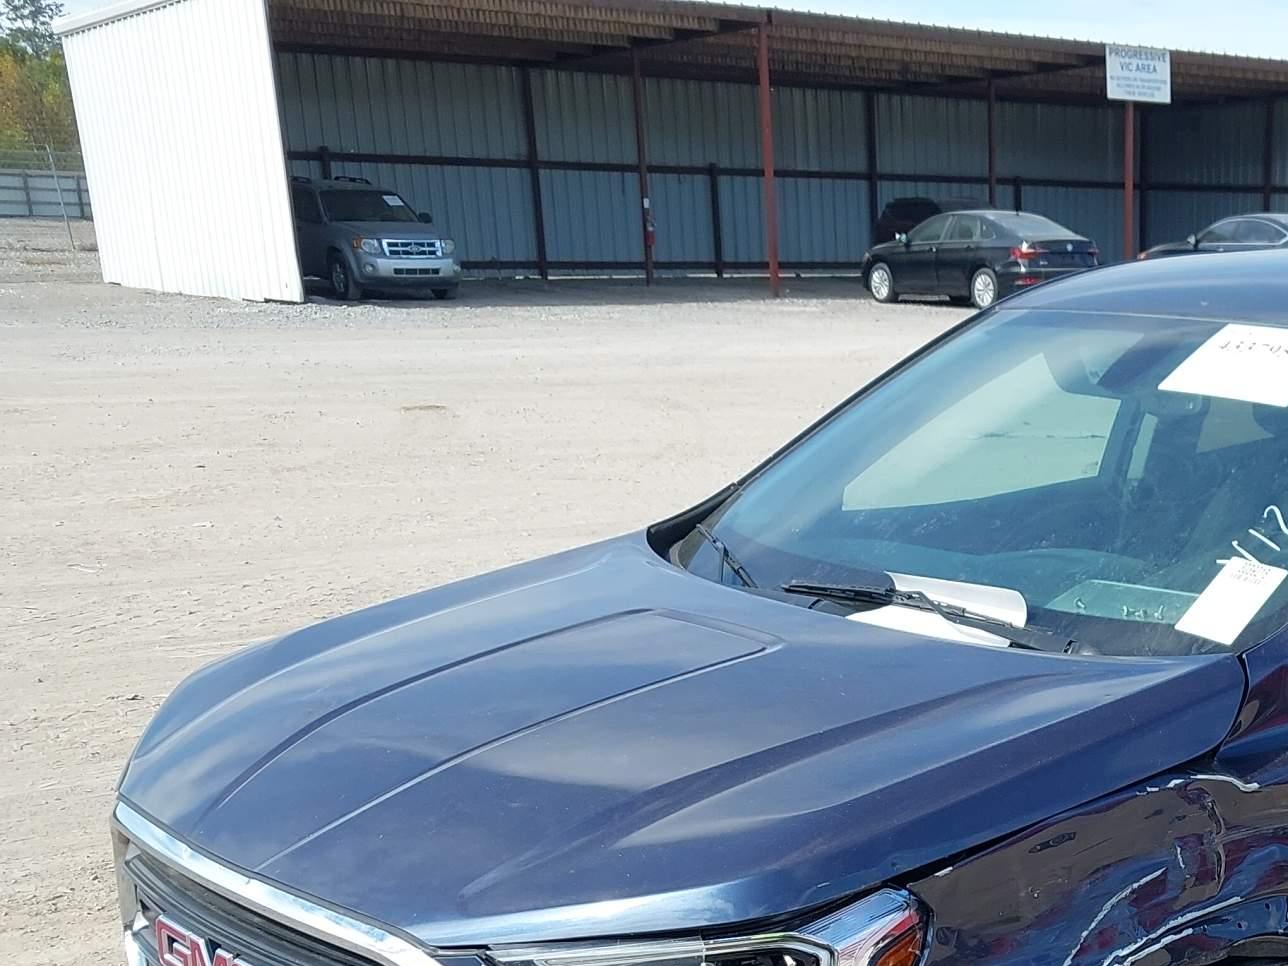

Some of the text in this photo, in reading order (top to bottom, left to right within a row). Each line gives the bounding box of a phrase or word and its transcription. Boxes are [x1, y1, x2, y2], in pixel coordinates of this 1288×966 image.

[1109, 47, 1167, 63] PROGRESSIVE
[1120, 61, 1158, 74] VIC AREA
